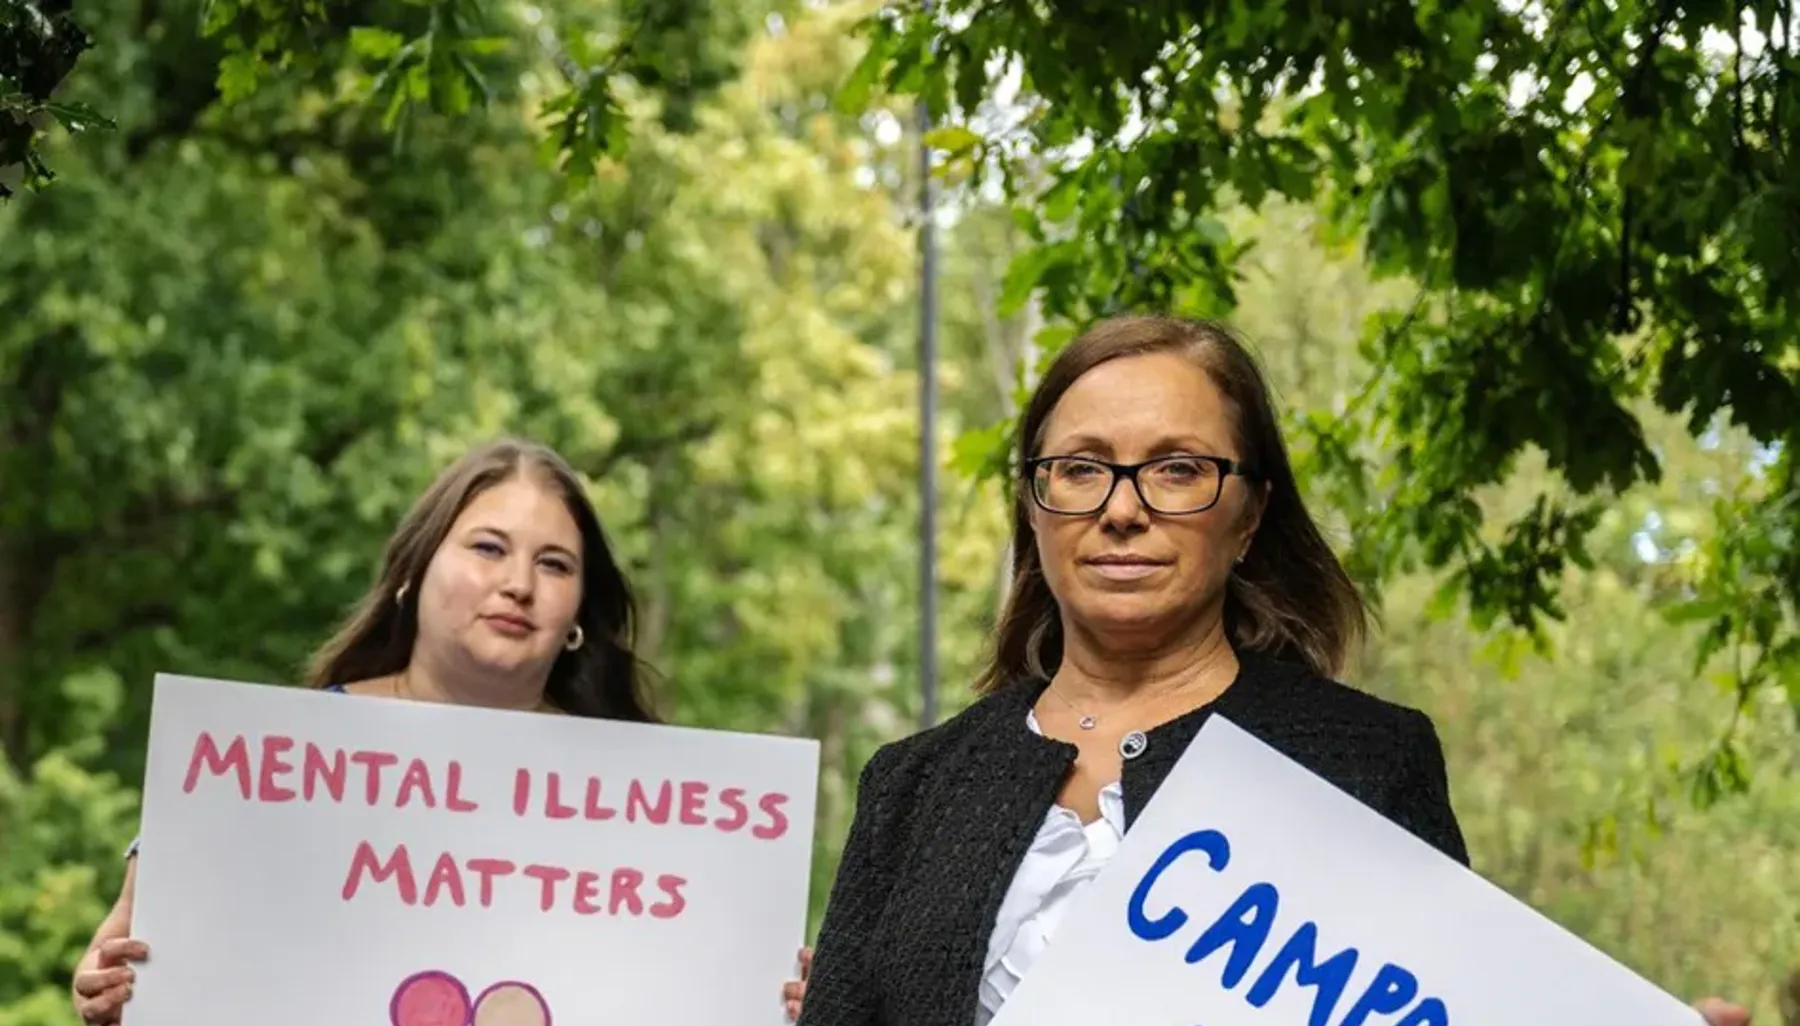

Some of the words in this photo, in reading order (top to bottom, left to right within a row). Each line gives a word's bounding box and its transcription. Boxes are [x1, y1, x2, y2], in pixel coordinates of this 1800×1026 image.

[183, 731, 479, 812] MENTAL
[513, 768, 790, 841] ILLNESS
[341, 842, 687, 919] MATTERS
